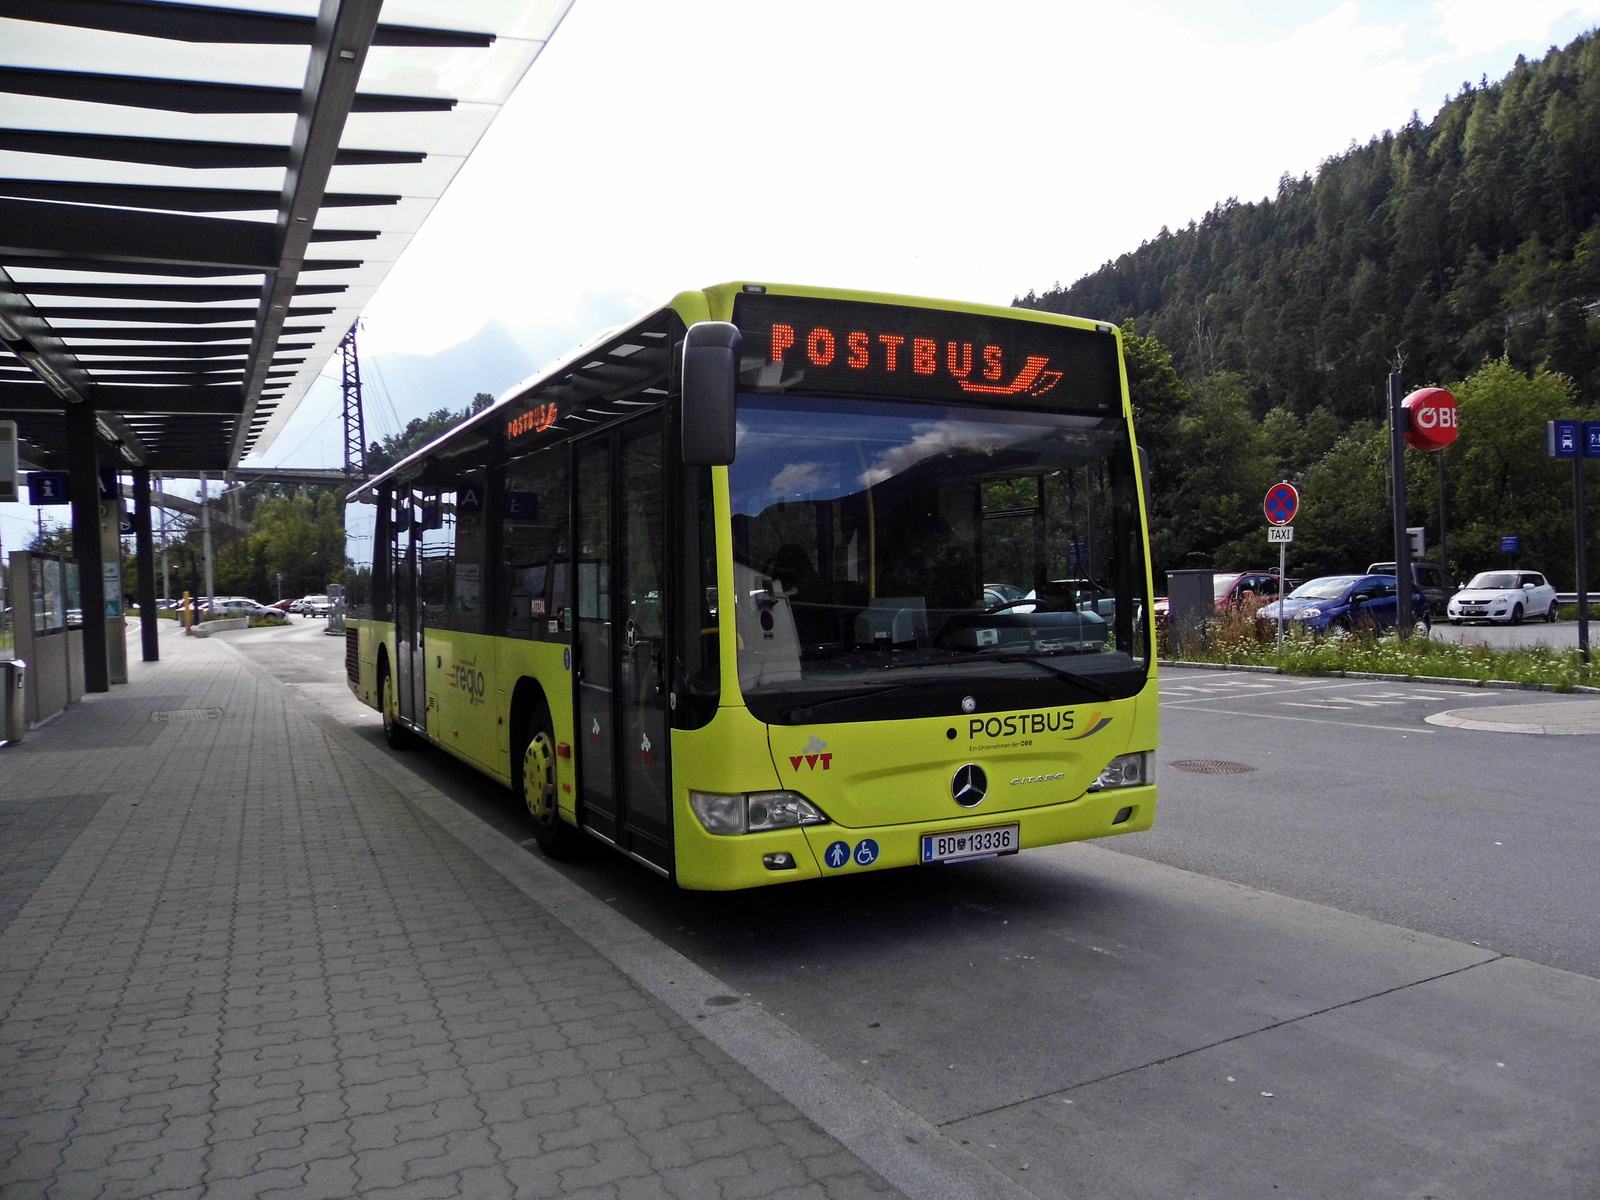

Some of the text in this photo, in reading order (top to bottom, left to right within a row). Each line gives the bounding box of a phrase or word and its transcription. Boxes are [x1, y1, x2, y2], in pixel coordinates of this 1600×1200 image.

[771, 323, 1002, 381] POSTBUS
[507, 403, 546, 440] POSTBUS
[1270, 529, 1291, 540] TAXI
[969, 710, 1075, 740] POSTBUS
[788, 752, 833, 773] VVT
[1010, 772, 1066, 786] CITARO
[938, 830, 1010, 856] BD 13336
